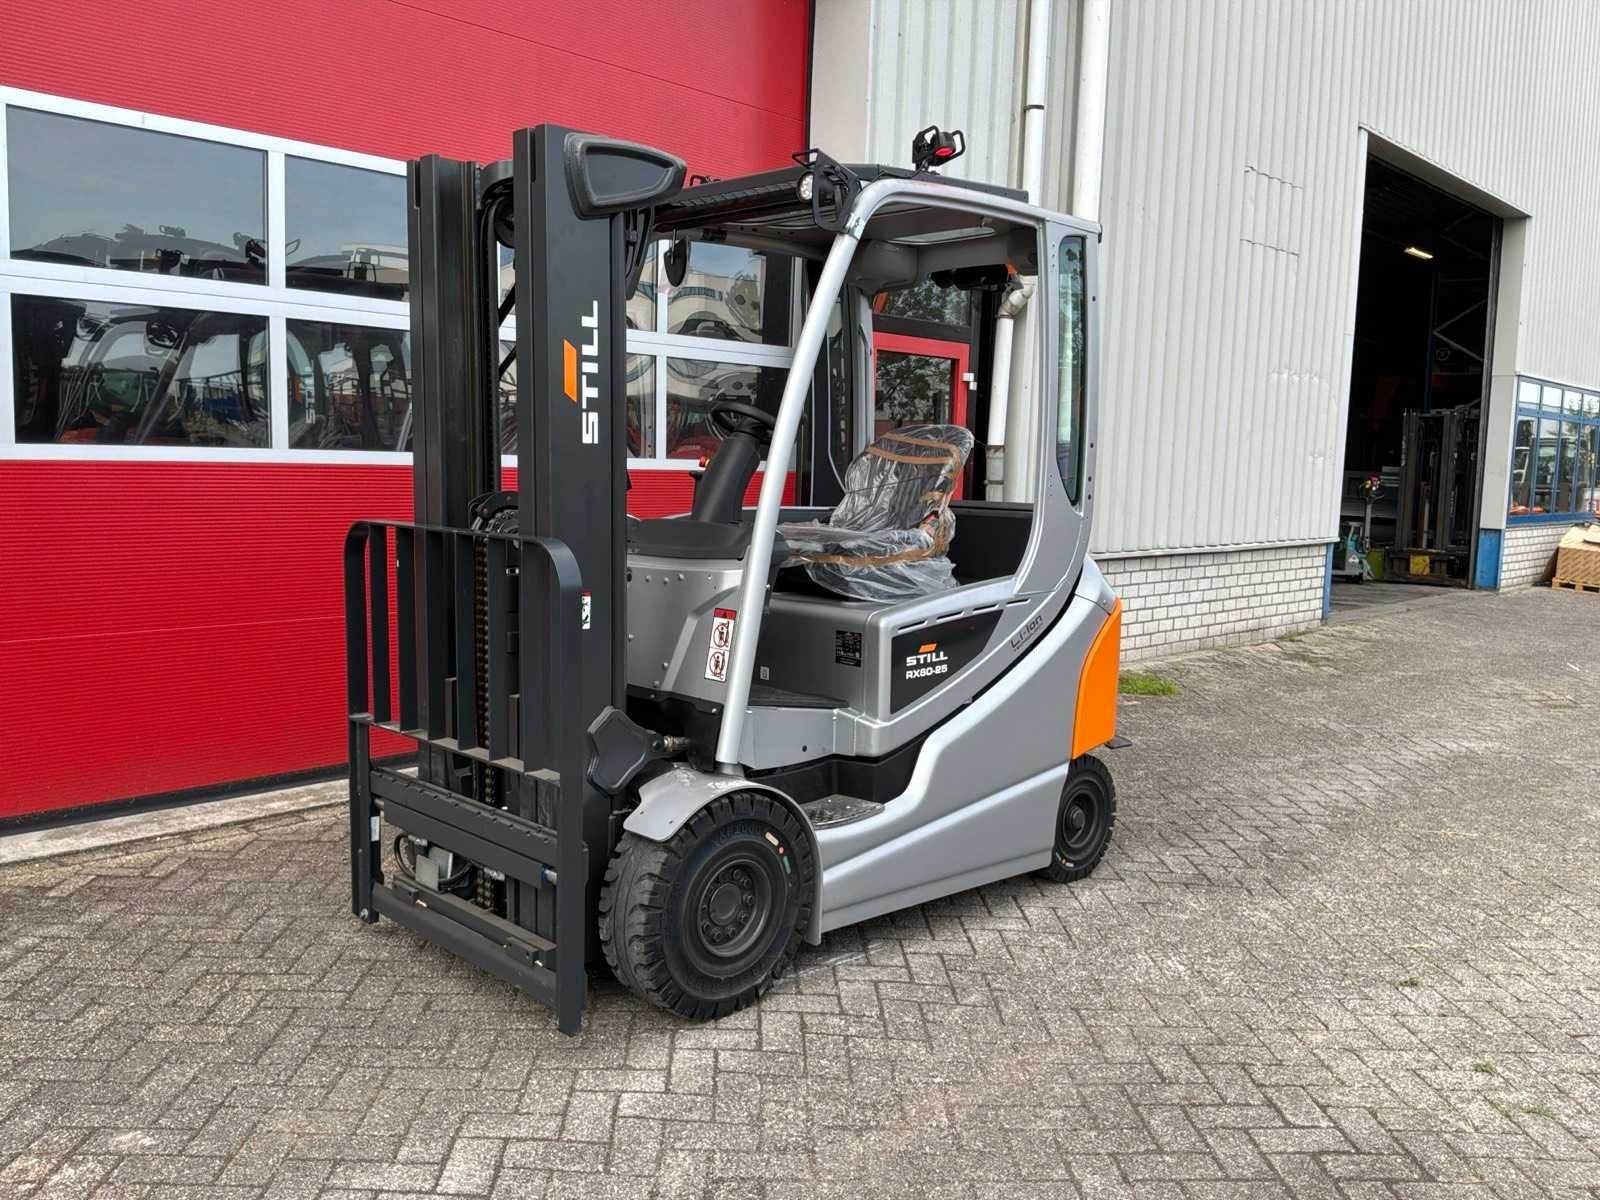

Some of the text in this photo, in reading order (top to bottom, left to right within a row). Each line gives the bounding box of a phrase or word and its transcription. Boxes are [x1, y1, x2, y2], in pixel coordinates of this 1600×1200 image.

[581, 300, 599, 444] STILL
[906, 651, 949, 667] STILL
[905, 663, 948, 680] RX60-25
